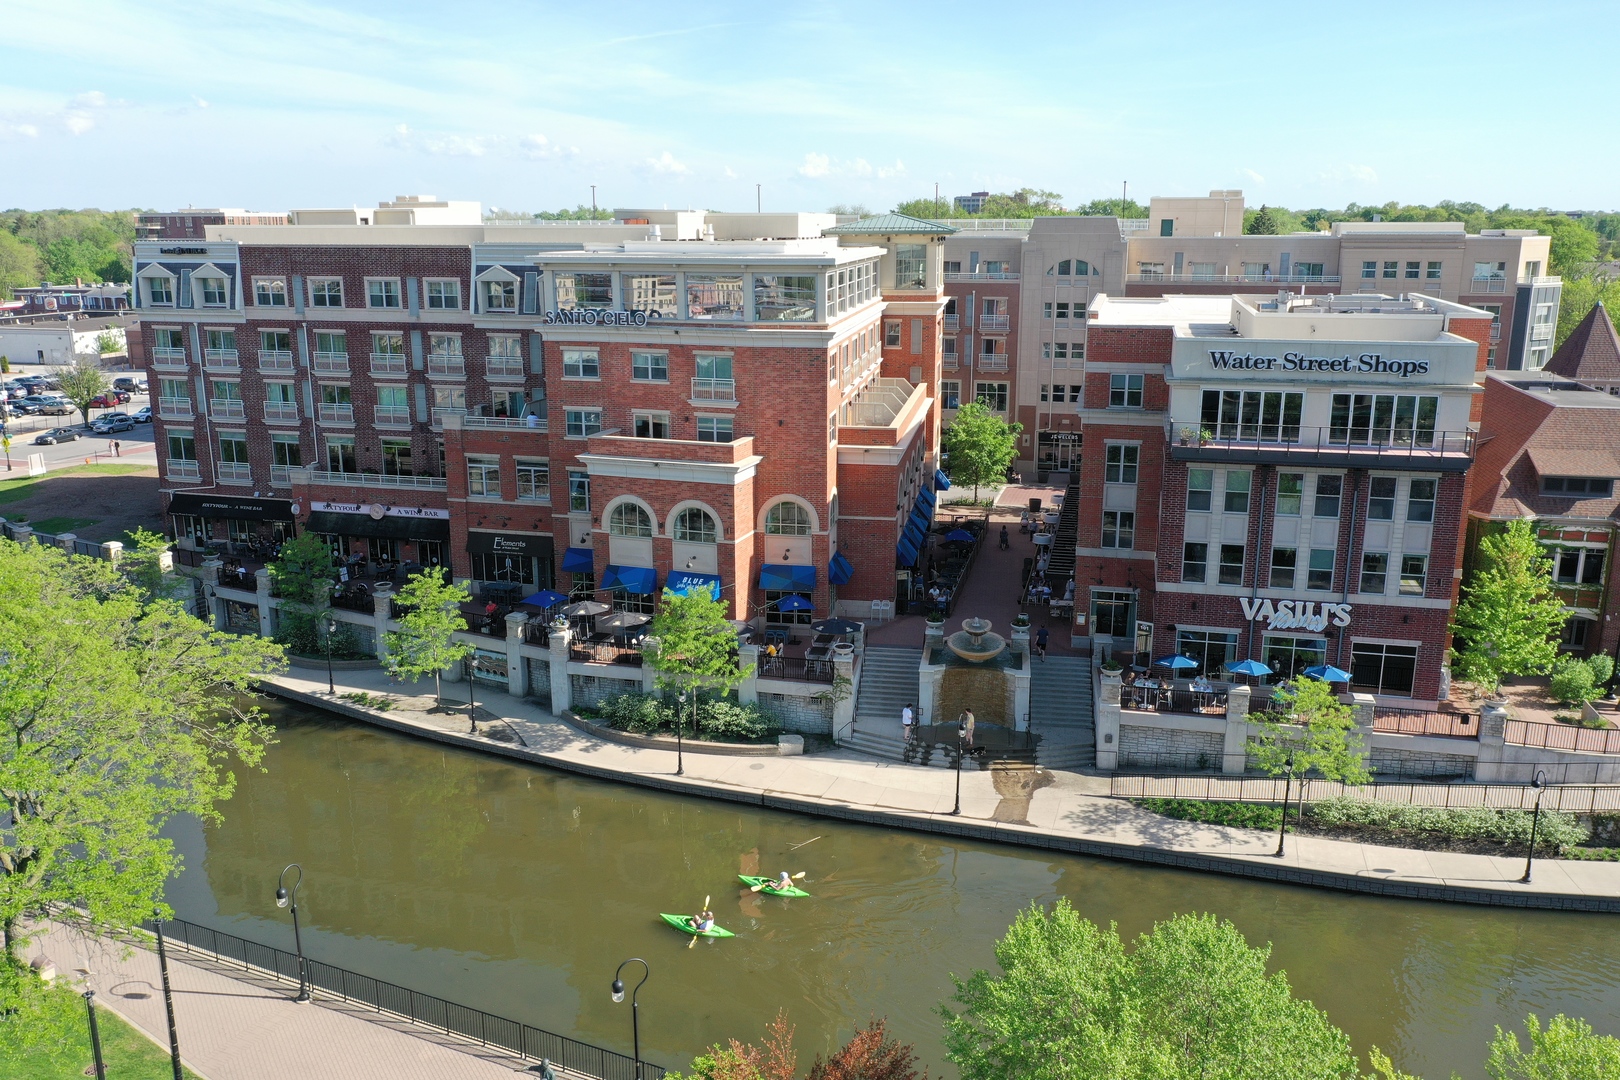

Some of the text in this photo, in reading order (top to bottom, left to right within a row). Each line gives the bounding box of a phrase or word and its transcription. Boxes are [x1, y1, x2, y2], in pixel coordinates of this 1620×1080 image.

[545, 309, 648, 327] SANTO CIELO
[1207, 350, 1429, 378] Water Street Shops
[493, 536, 526, 549] Elements
[682, 577, 703, 585] BLUE
